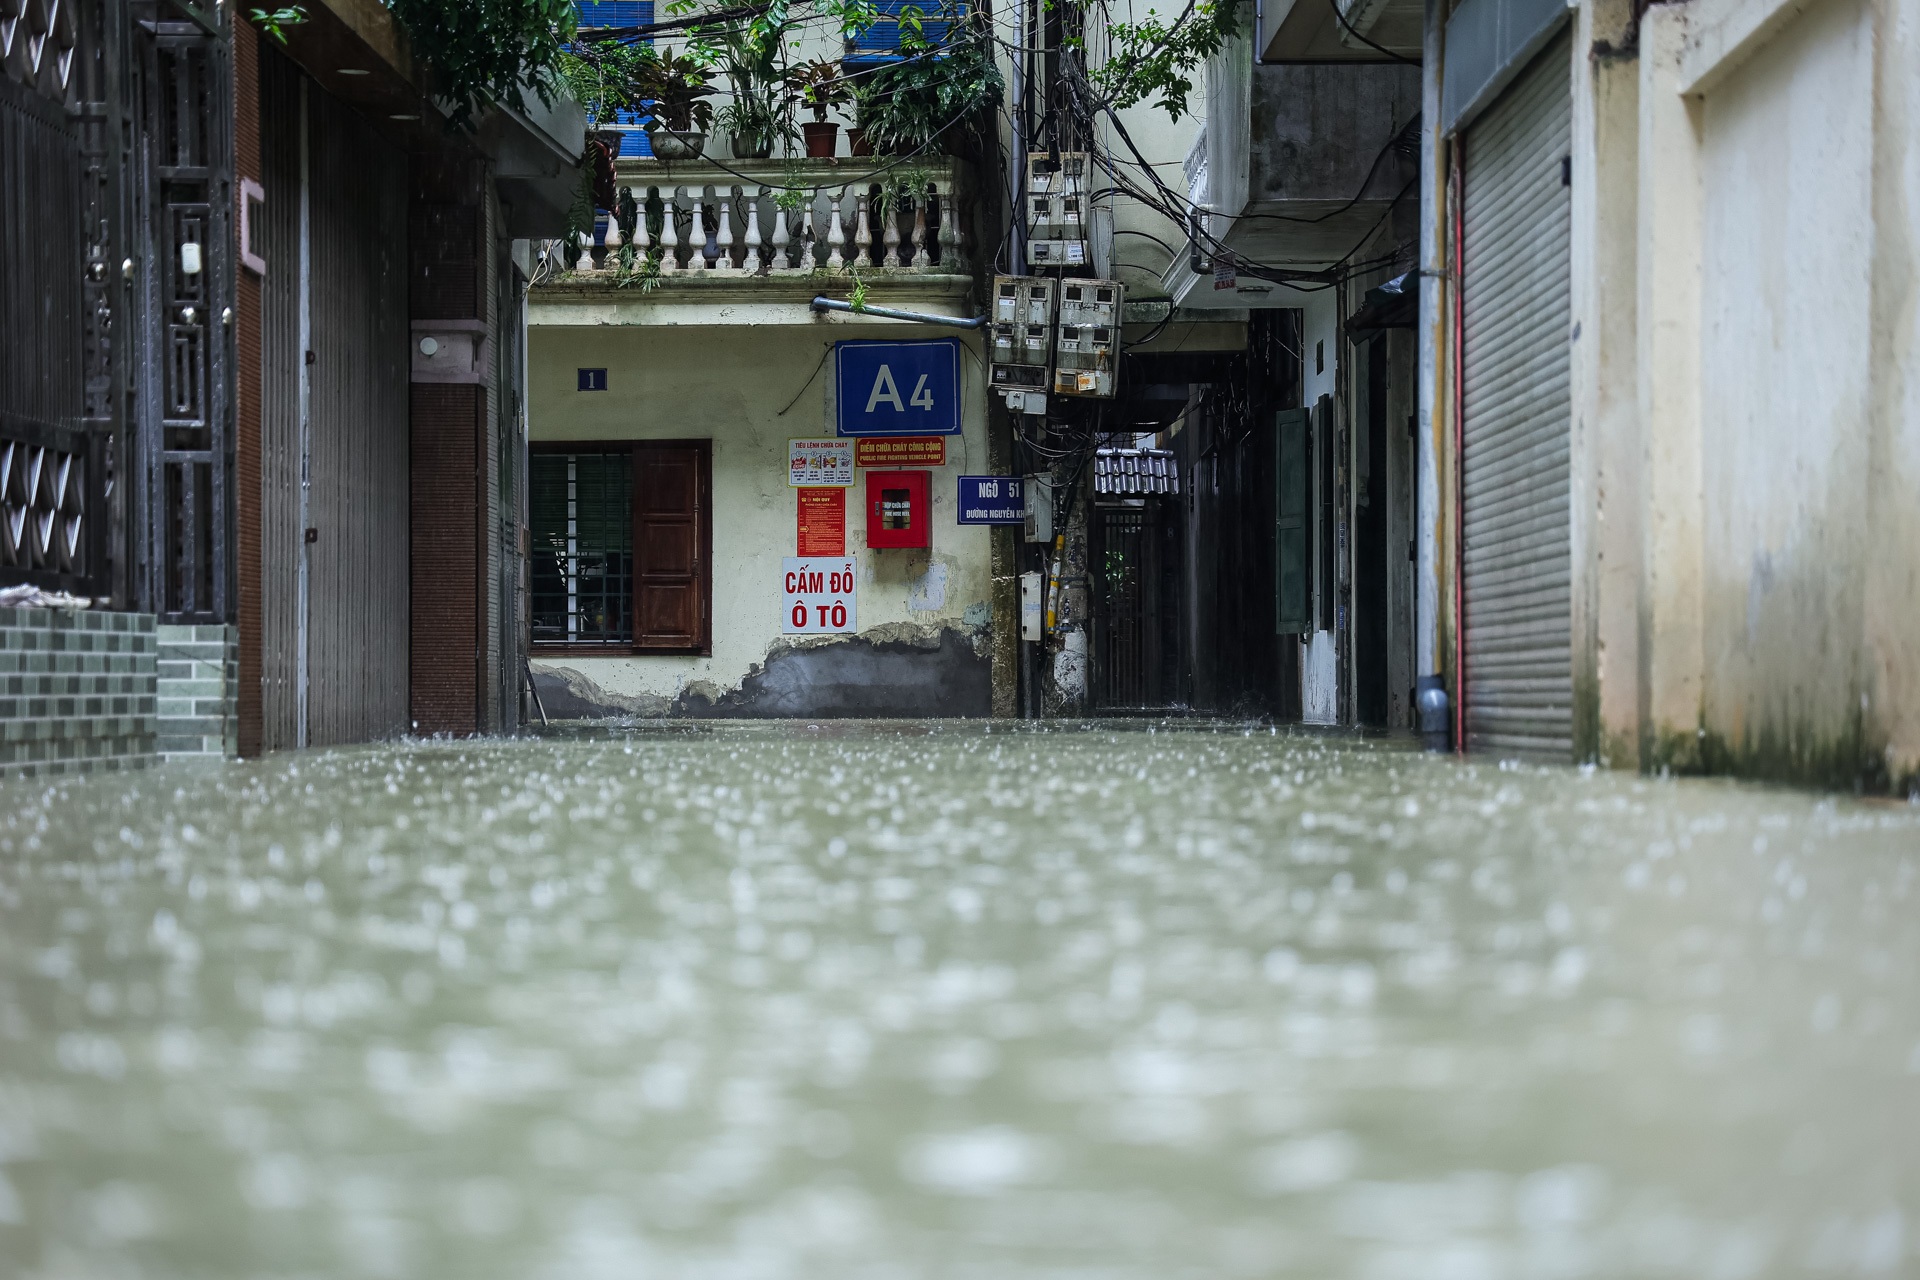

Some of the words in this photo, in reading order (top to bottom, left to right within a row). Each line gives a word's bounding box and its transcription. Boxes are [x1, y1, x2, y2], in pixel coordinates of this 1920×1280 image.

[588, 371, 595, 389] 1
[865, 364, 934, 413] A4
[893, 442, 907, 452] CHÁY
[909, 442, 924, 452] CÔNG
[925, 441, 941, 453] CỘNG
[978, 480, 999, 498] NGÕ
[1008, 482, 1020, 498] 51
[966, 507, 988, 519] ĐƯỜNG
[989, 507, 1015, 519] NGUYỄN
[785, 564, 823, 594] CẤM
[829, 563, 853, 594] ĐỖ
[792, 600, 807, 628] Ô
[816, 600, 847, 628] TÔ
